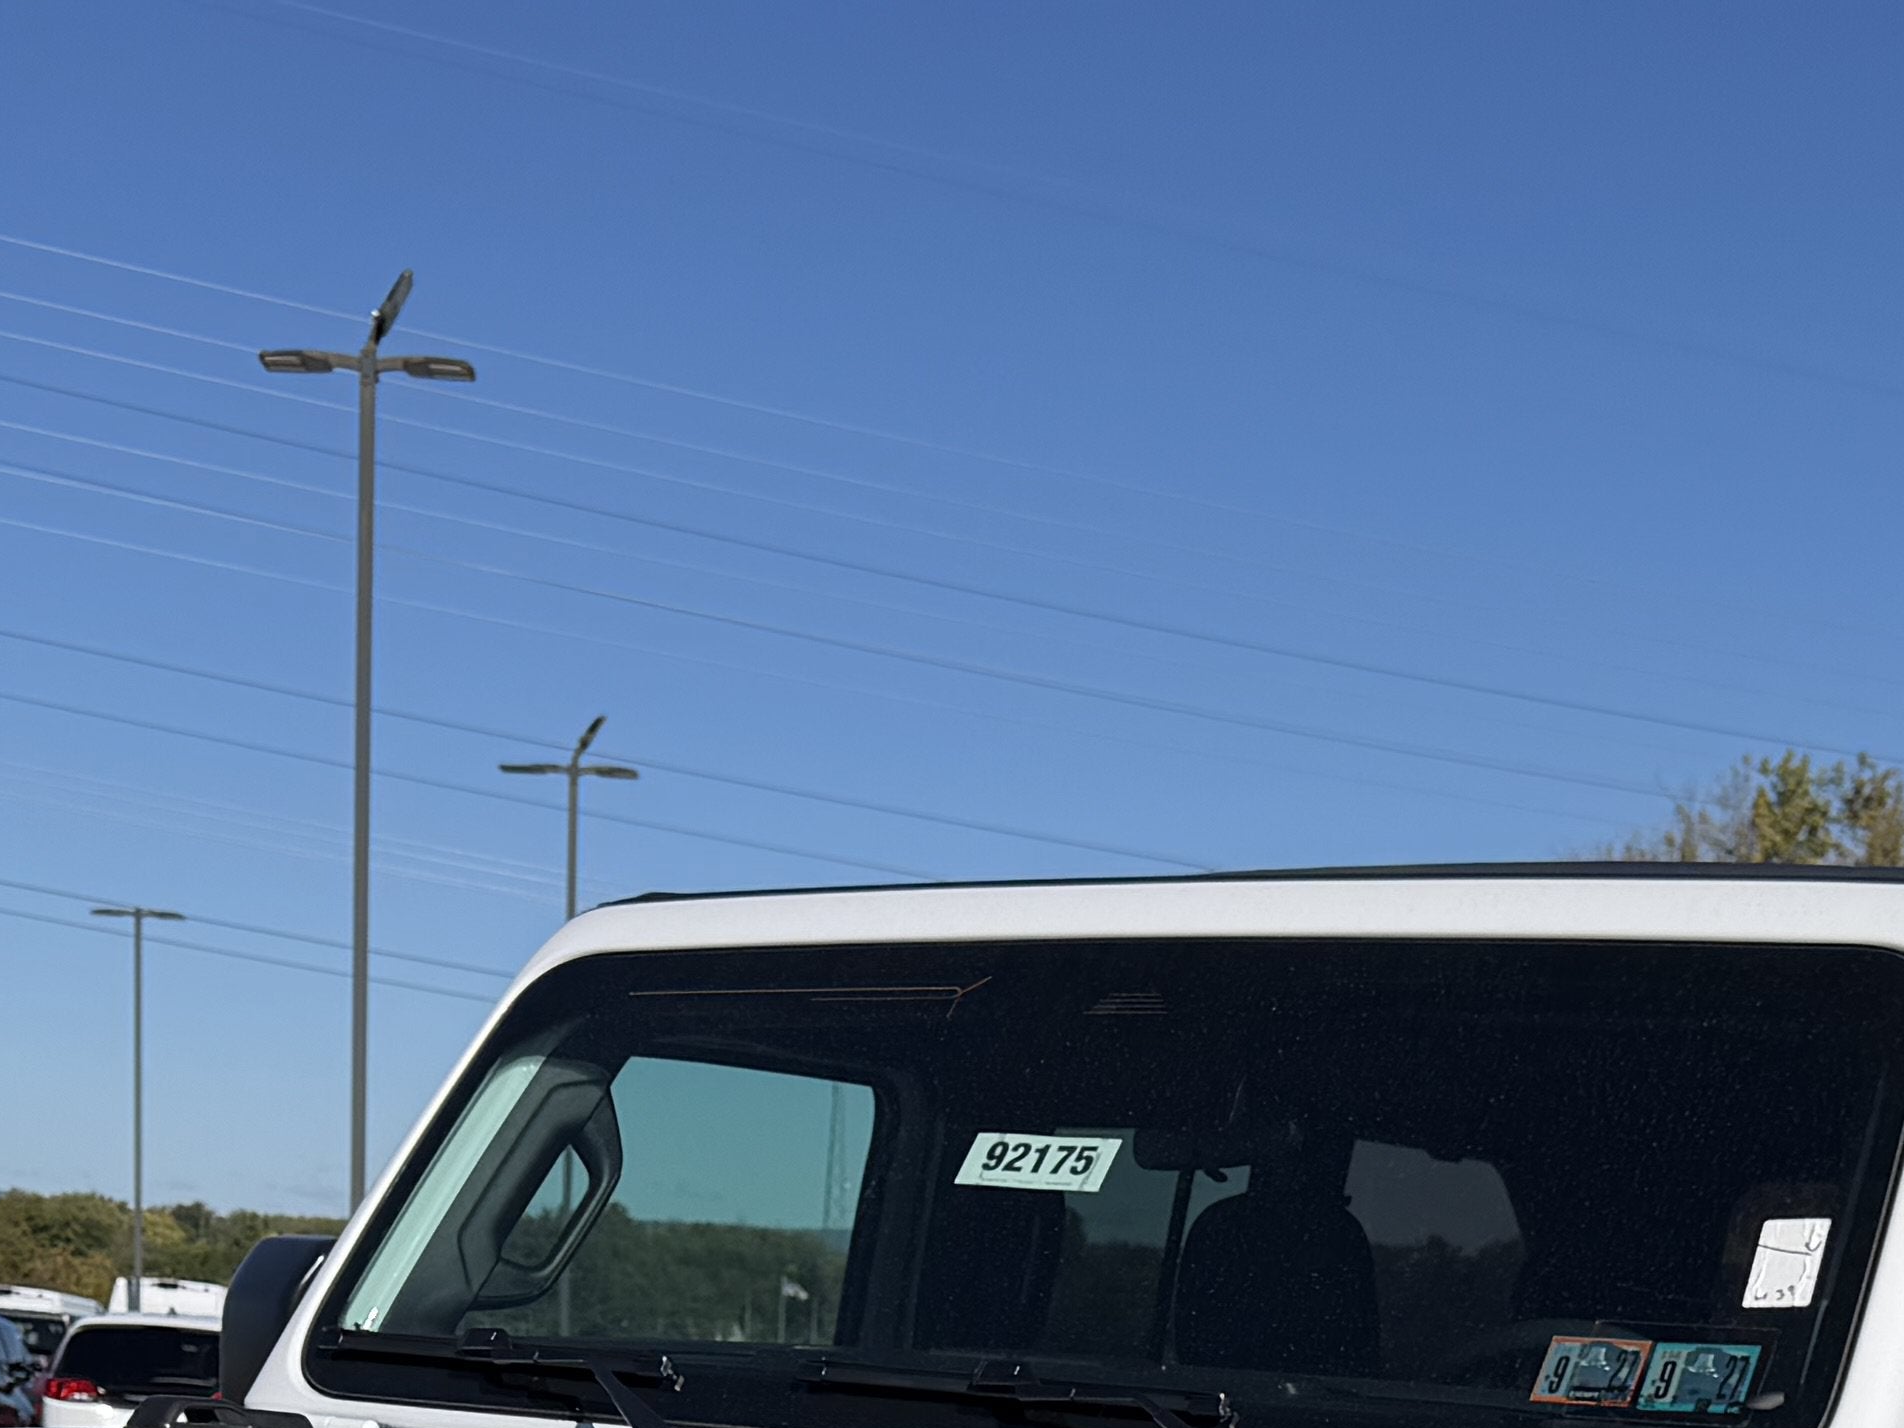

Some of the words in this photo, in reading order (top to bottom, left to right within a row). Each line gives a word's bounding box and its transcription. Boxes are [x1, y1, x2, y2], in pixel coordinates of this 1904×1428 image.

[982, 1141, 1099, 1176] 92175
[1548, 1356, 1570, 1394] 9
[1608, 1350, 1640, 1389] 27
[1654, 1361, 1677, 1399] 9
[1717, 1355, 1750, 1400] 27
